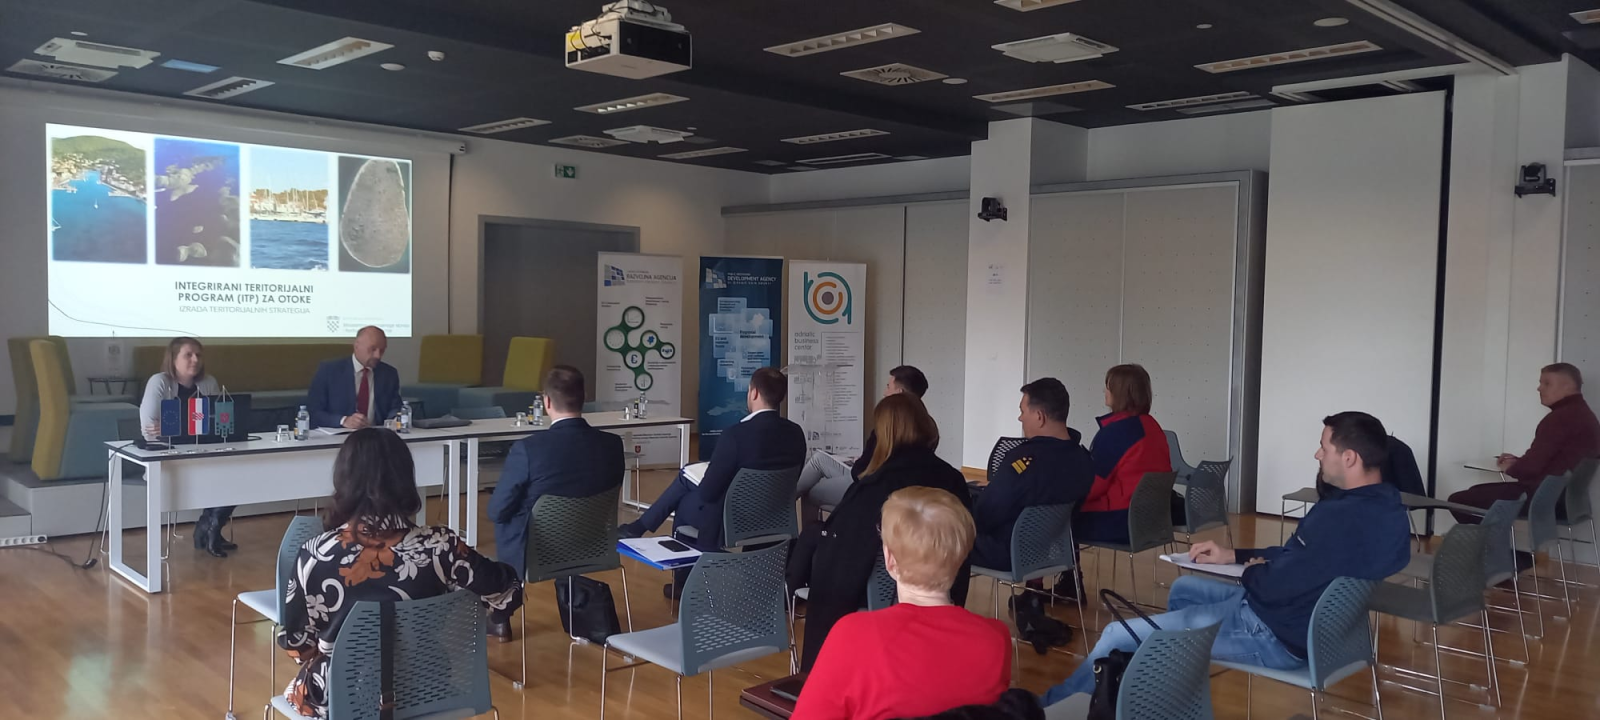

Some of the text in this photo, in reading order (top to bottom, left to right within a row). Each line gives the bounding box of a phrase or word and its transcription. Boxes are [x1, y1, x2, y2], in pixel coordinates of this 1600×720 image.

[175, 281, 314, 293] INTEGRIRANI TERITORIJALNI
[178, 292, 311, 304] PROGRAM (ITP) ZA OTOKE
[179, 305, 208, 313] IZRADA
[210, 306, 267, 314] TERITORIJALNIH
